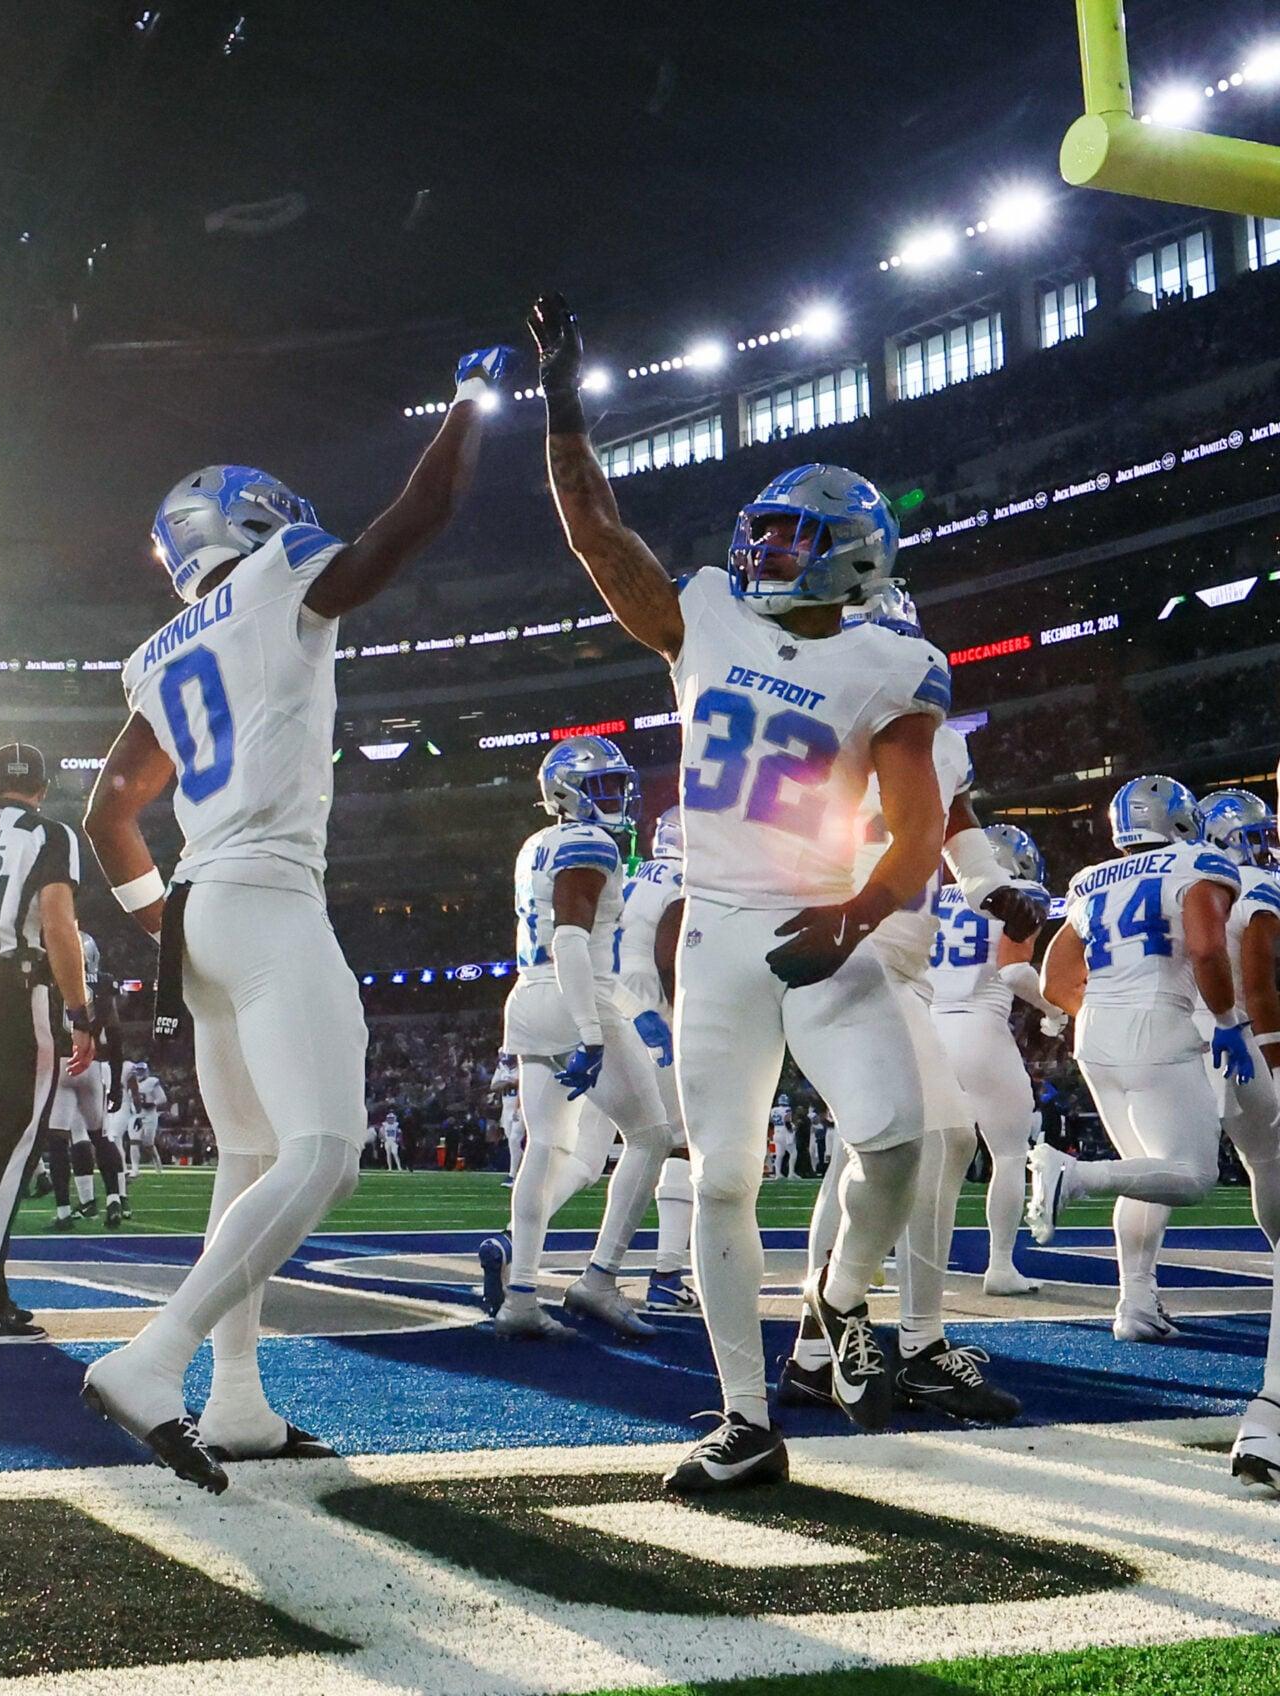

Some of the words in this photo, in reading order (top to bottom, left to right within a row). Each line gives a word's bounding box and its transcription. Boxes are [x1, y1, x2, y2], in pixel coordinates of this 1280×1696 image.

[143, 582, 233, 673] ARNOLD
[948, 635, 1032, 666] BUCCANEERS
[1097, 613, 1119, 632] 2024
[725, 665, 826, 711] DETROIT
[159, 642, 235, 807] 0
[478, 731, 538, 749] COWBOYS
[552, 720, 626, 740] BUCCANEERS
[684, 686, 842, 842] 32
[1074, 853, 1178, 898] RODRIGUEZ
[1084, 876, 1172, 972] 14
